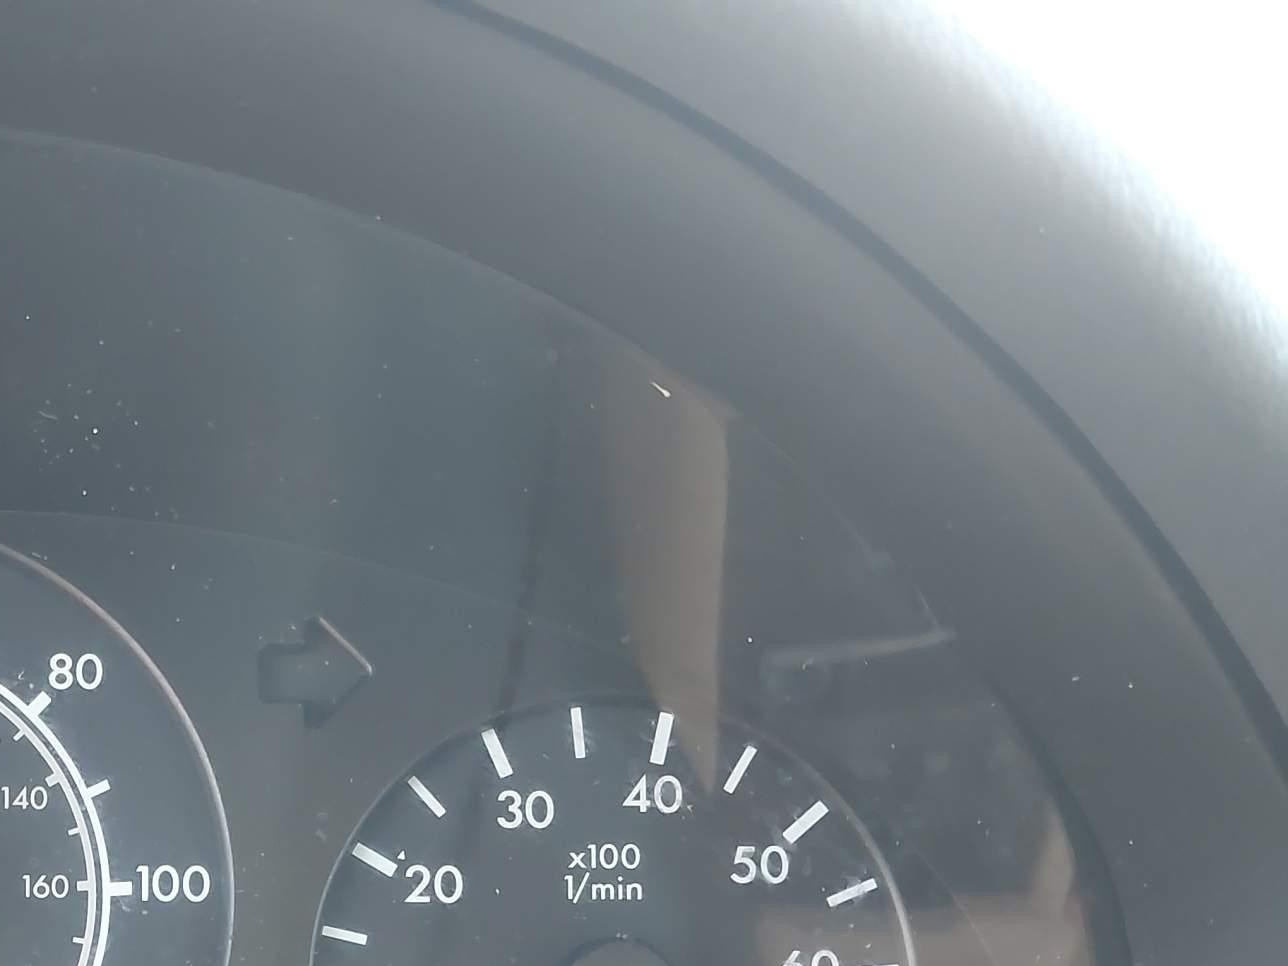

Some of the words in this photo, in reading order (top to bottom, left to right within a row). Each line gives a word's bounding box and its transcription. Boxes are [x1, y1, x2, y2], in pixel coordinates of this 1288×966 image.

[48, 653, 103, 690] 80
[1, 785, 48, 810] 140
[497, 790, 555, 829] 30
[622, 774, 683, 814] 40
[568, 843, 641, 870] x100
[730, 845, 789, 884] 50
[22, 874, 69, 899] 160
[135, 864, 211, 903] 100
[404, 864, 464, 904] 20
[564, 871, 643, 904] 1/min
